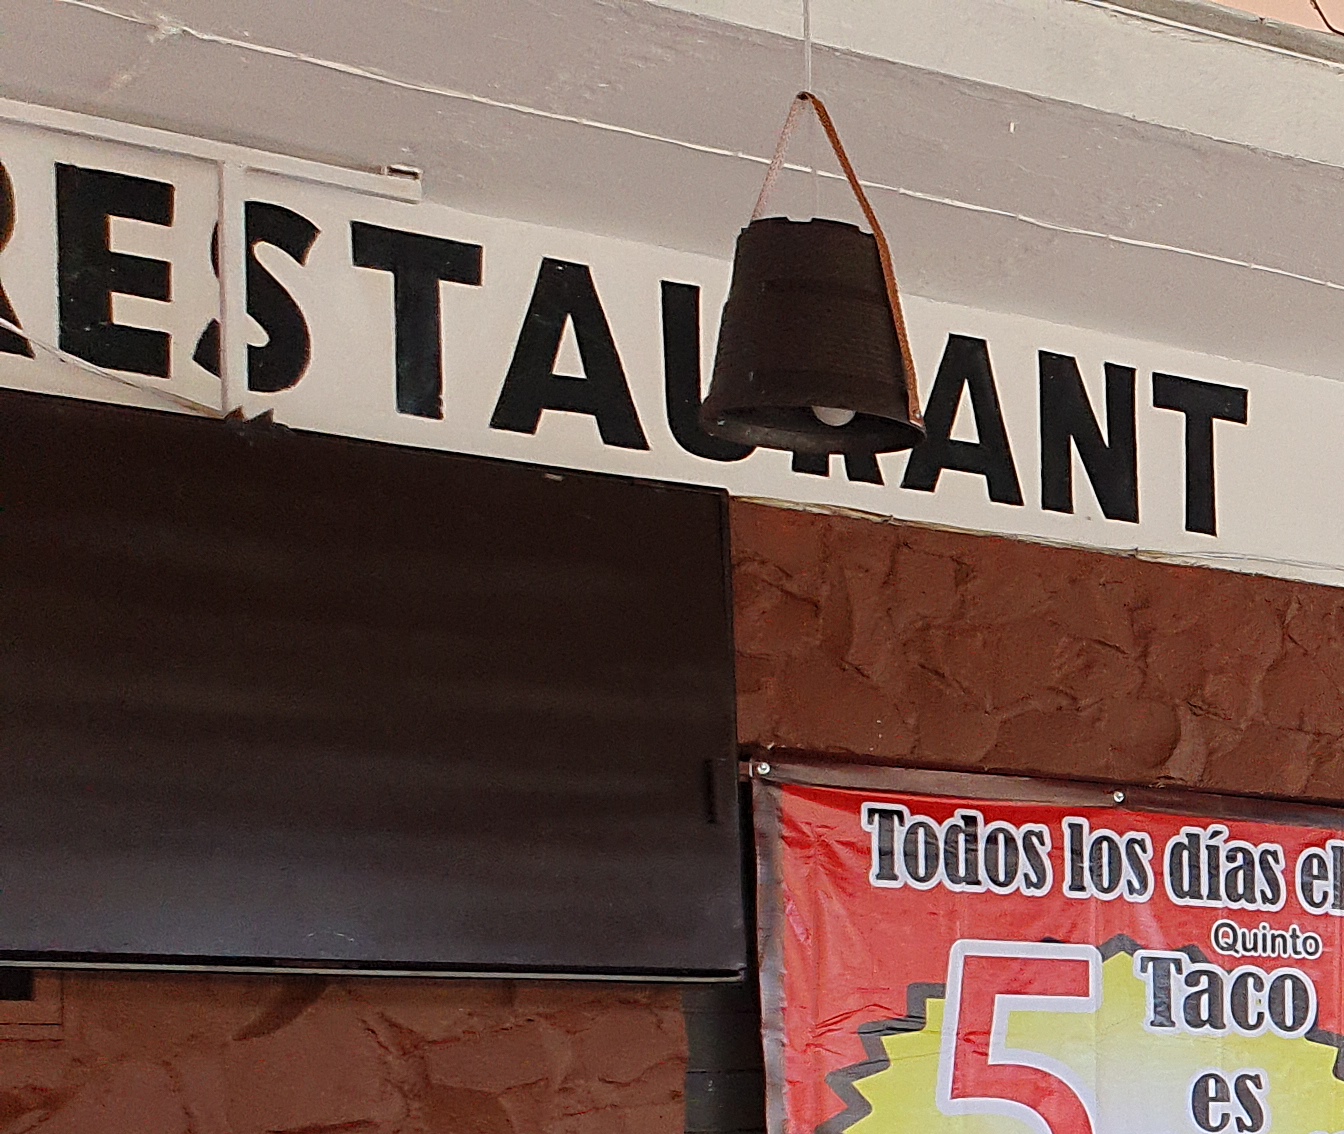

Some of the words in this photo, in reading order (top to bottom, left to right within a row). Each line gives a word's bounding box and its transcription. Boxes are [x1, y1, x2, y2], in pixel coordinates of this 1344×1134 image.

[0, 160, 1249, 537] ESTAUANT
[863, 804, 1050, 891] Todos
[1064, 816, 1154, 899] los
[1167, 825, 1286, 910] días
[1212, 921, 1321, 959] Quinto
[1134, 950, 1317, 1036] Taco
